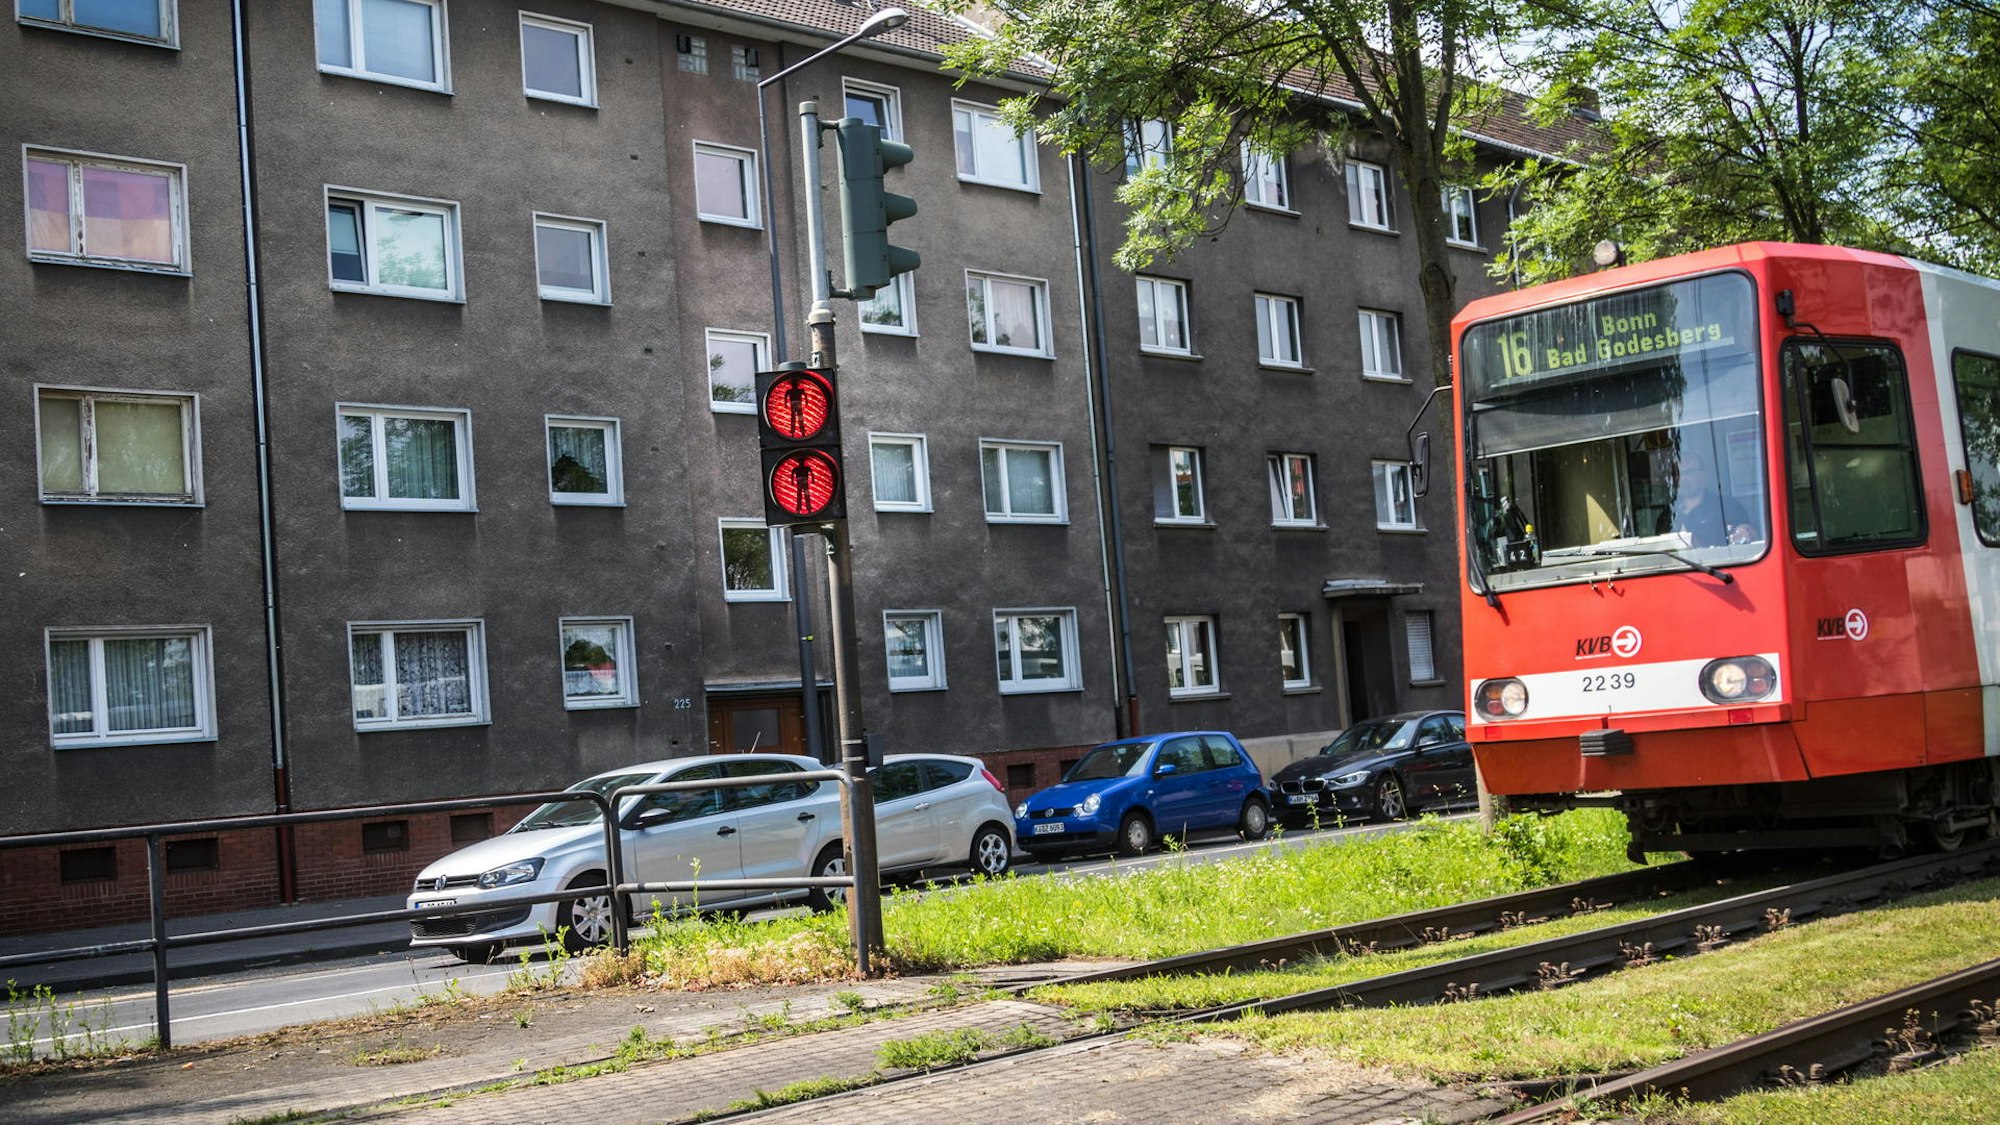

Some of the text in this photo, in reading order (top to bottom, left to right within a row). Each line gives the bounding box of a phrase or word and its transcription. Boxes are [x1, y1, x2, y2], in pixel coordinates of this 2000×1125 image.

[1601, 313, 1657, 336] Bonn
[1497, 331, 1532, 378] 16
[1546, 323, 1721, 369] Bad Godesberg
[1817, 617, 1845, 637] KVB
[1576, 636, 1611, 656] KVB
[1582, 672, 1636, 692] 2239
[674, 698, 692, 709] 225
